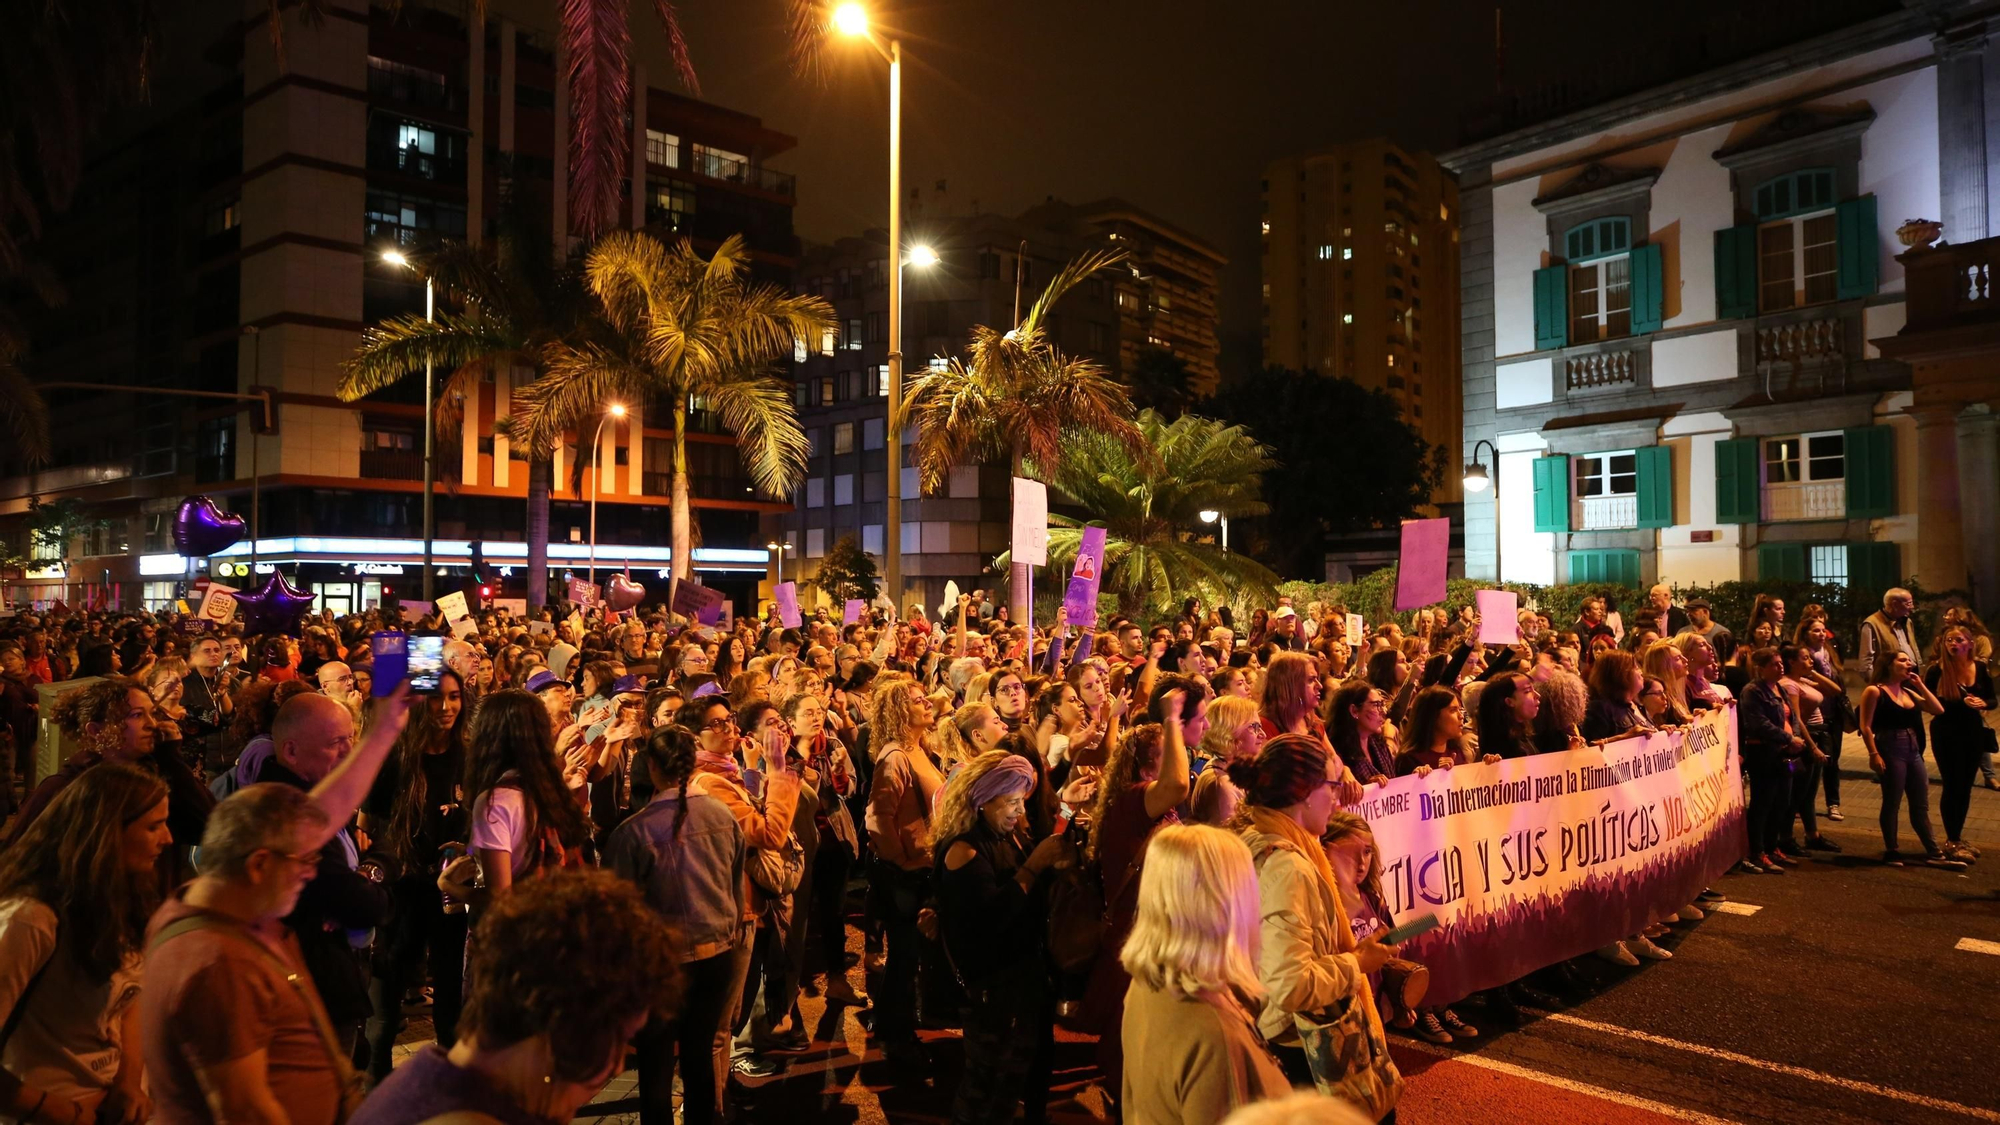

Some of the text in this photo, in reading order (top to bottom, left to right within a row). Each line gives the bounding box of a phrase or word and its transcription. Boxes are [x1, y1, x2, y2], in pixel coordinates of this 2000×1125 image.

[1419, 789, 1445, 821] Día
[1446, 776, 1531, 816] Internacional
[1535, 773, 1563, 803] para
[1566, 769, 1577, 794] la
[1632, 752, 1643, 778] de
[1643, 753, 1653, 775] la
[1652, 747, 1676, 774] violen
[1381, 845, 1465, 915] TICIA
[1473, 838, 1491, 893] Y
[1499, 827, 1549, 885] SUS
[1558, 799, 1660, 872] POLÍTICAS
[1661, 793, 1692, 841] NOS
